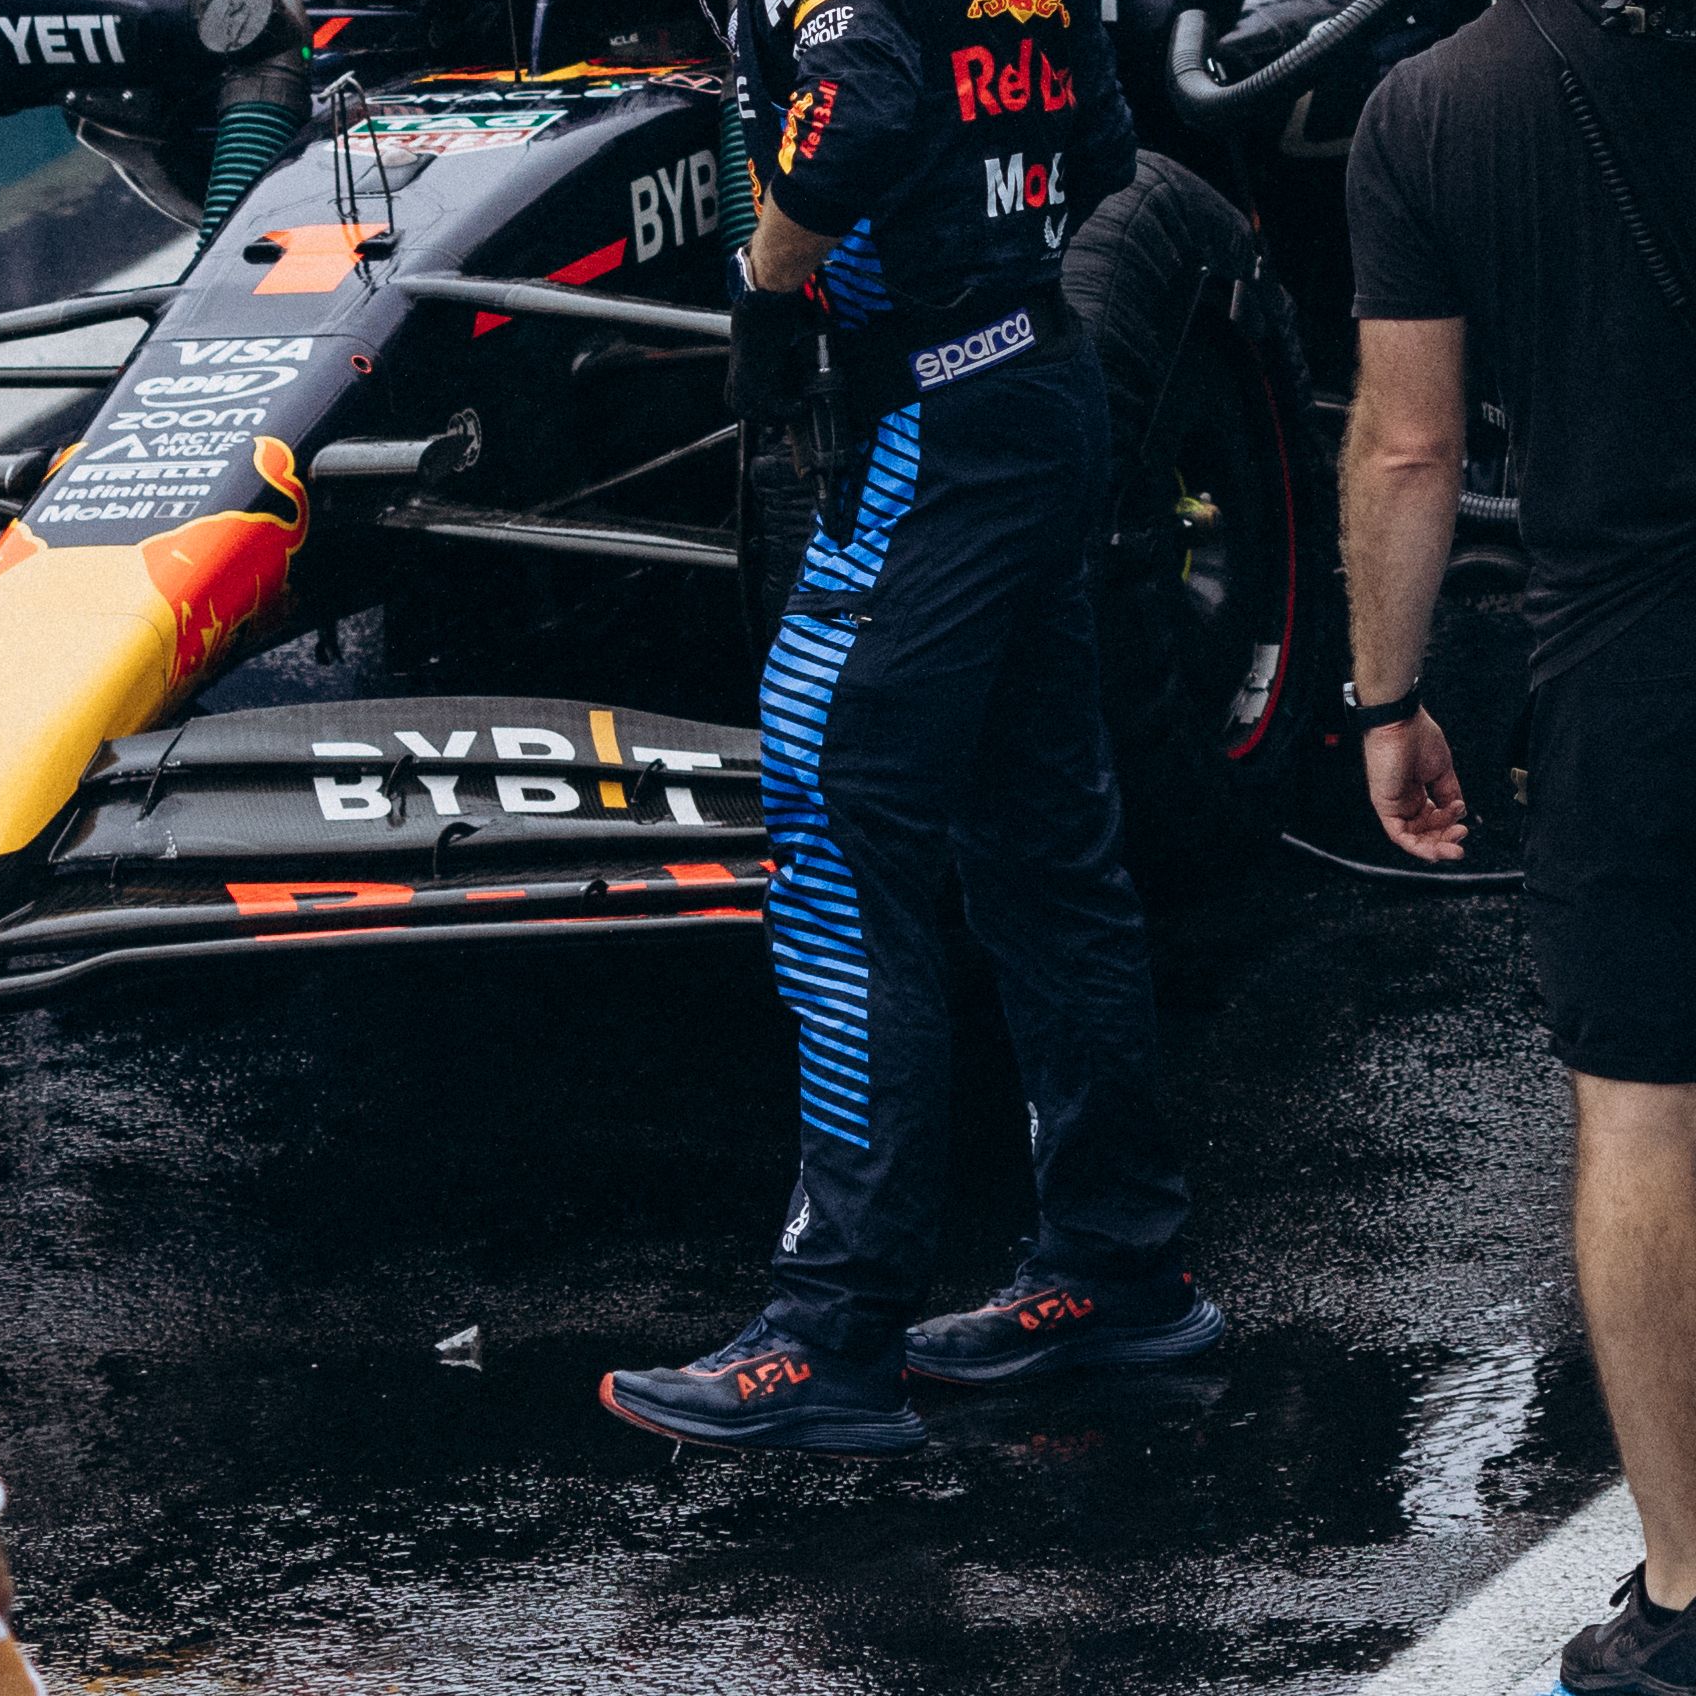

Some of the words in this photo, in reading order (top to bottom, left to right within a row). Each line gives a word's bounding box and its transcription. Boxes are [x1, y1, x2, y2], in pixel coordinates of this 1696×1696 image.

[376, 114, 542, 130] TAG
[631, 149, 720, 264] BYB
[172, 337, 314, 365] VISA
[915, 312, 1035, 387] sparco
[108, 408, 267, 430] zoom
[148, 430, 251, 445] ARCTIC
[157, 443, 235, 457] WOLF
[68, 460, 228, 482] PIRELLI
[53, 483, 211, 502] Infinitum
[38, 502, 150, 523] Mobil
[312, 709, 722, 826] BYBIT
